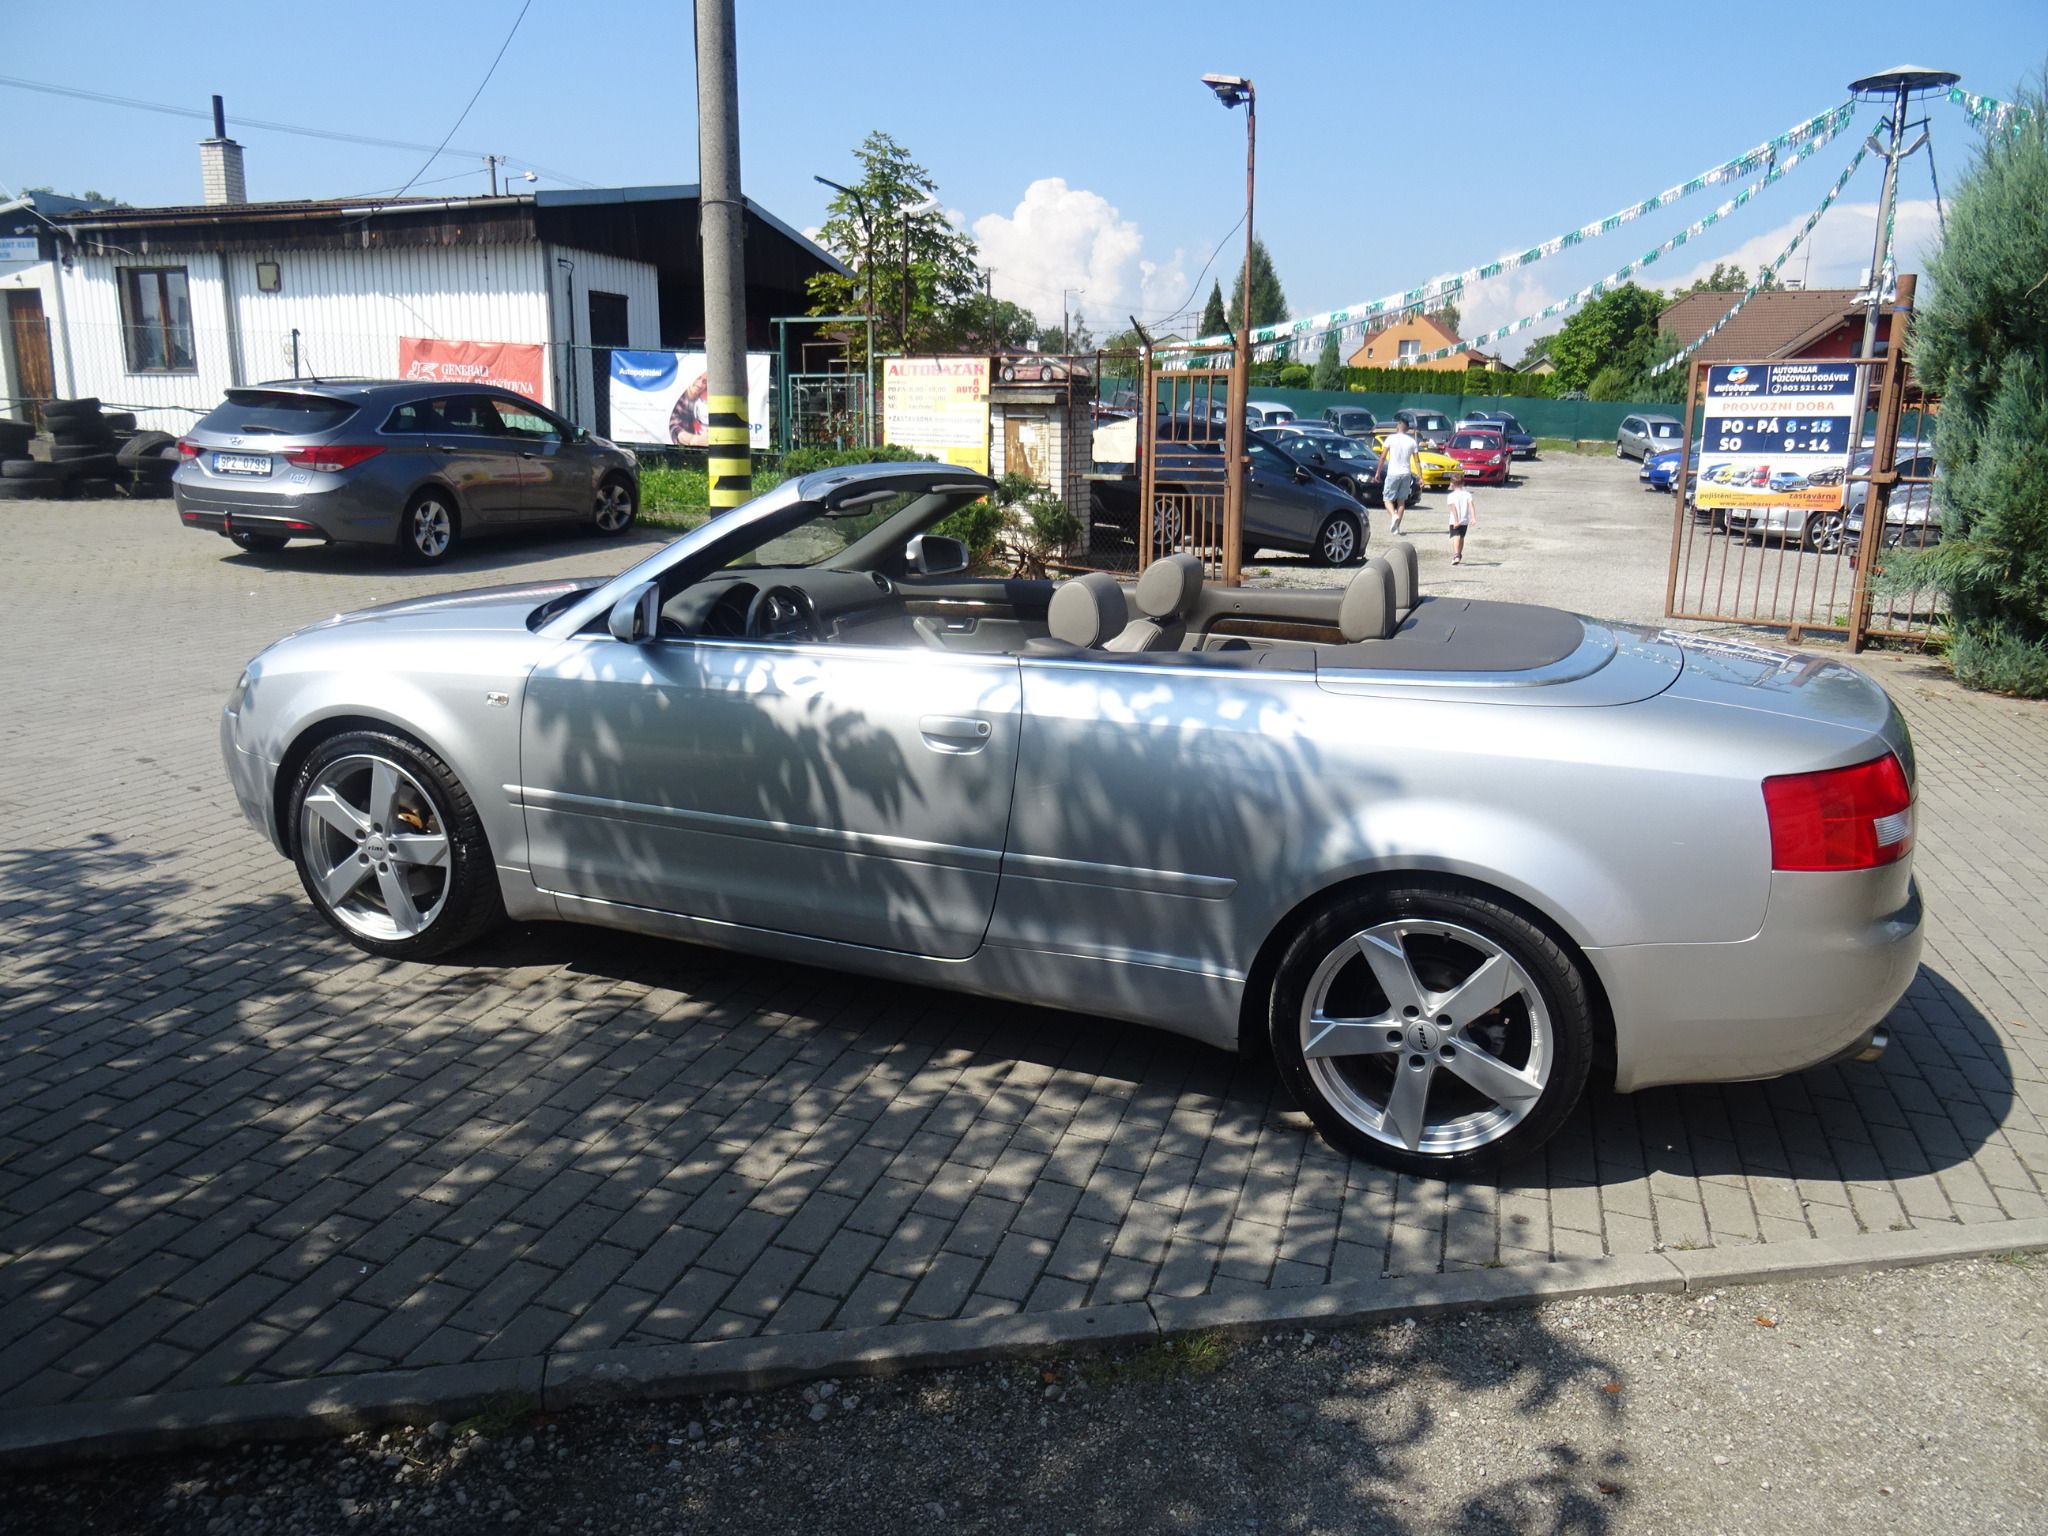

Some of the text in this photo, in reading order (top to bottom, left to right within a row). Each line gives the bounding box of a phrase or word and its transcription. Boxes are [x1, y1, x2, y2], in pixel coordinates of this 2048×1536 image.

[441, 363, 489, 377] GENERALI
[1772, 366, 1818, 374] AUTOBAZAR
[1772, 373, 1849, 382] PŮJČOVNA DODÁVEK
[1714, 383, 1760, 393] autobazar
[1722, 400, 1836, 412] PROVOZNÍ DOBA
[1721, 420, 1744, 434] PO
[1756, 418, 1779, 433] PÁ
[1785, 420, 1797, 433] 8
[1718, 437, 1742, 451] SO
[1783, 438, 1796, 452] 9
[1808, 438, 1831, 452] 14
[220, 455, 267, 470] 9P2 0799
